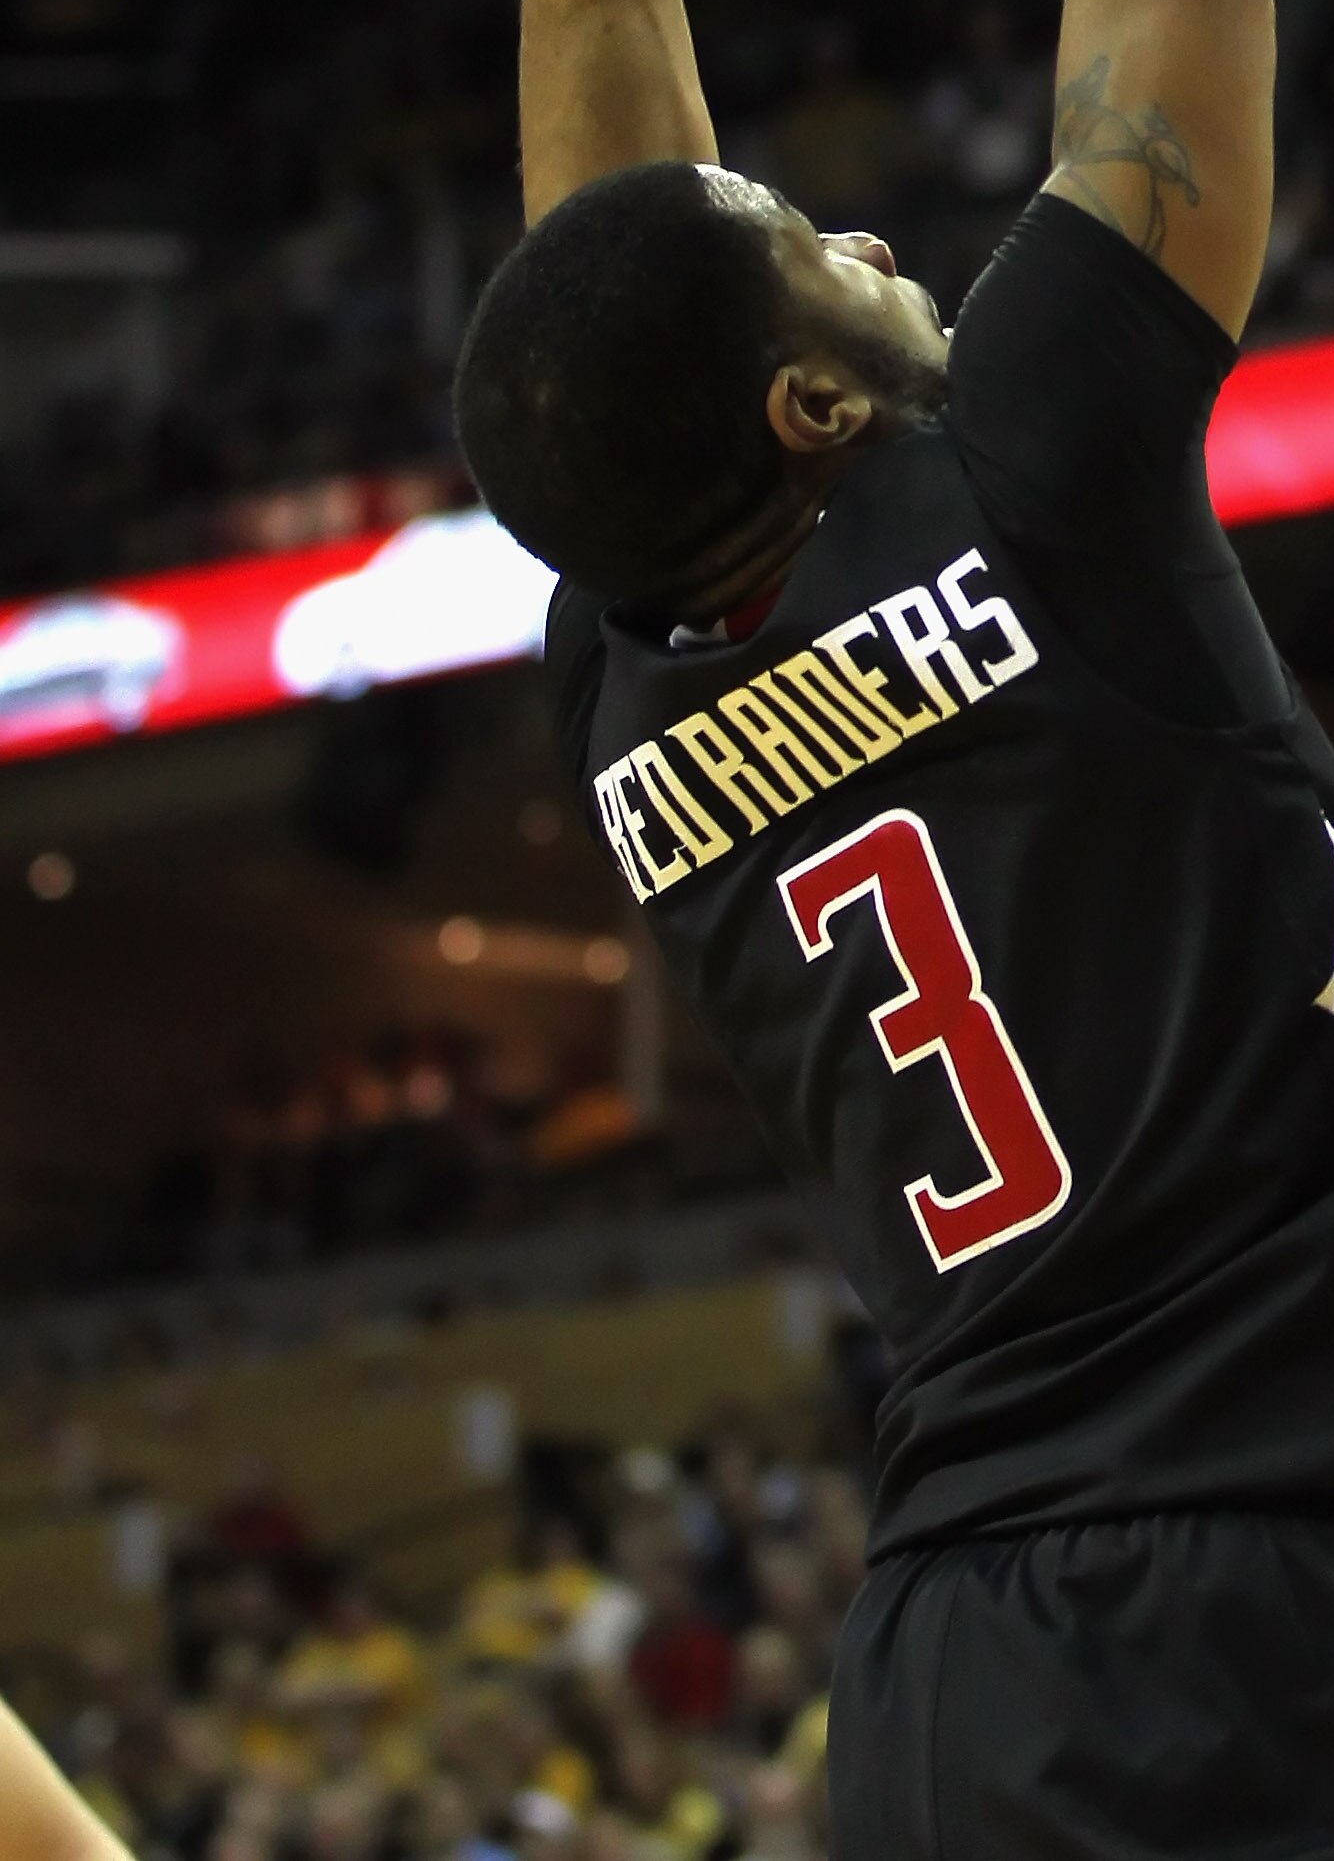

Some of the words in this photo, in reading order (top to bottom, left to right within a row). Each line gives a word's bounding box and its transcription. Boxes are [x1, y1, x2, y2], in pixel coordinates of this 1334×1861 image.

[593, 740, 734, 905] RED
[664, 548, 1040, 837] RAIDERS
[775, 807, 1073, 1274] 3
